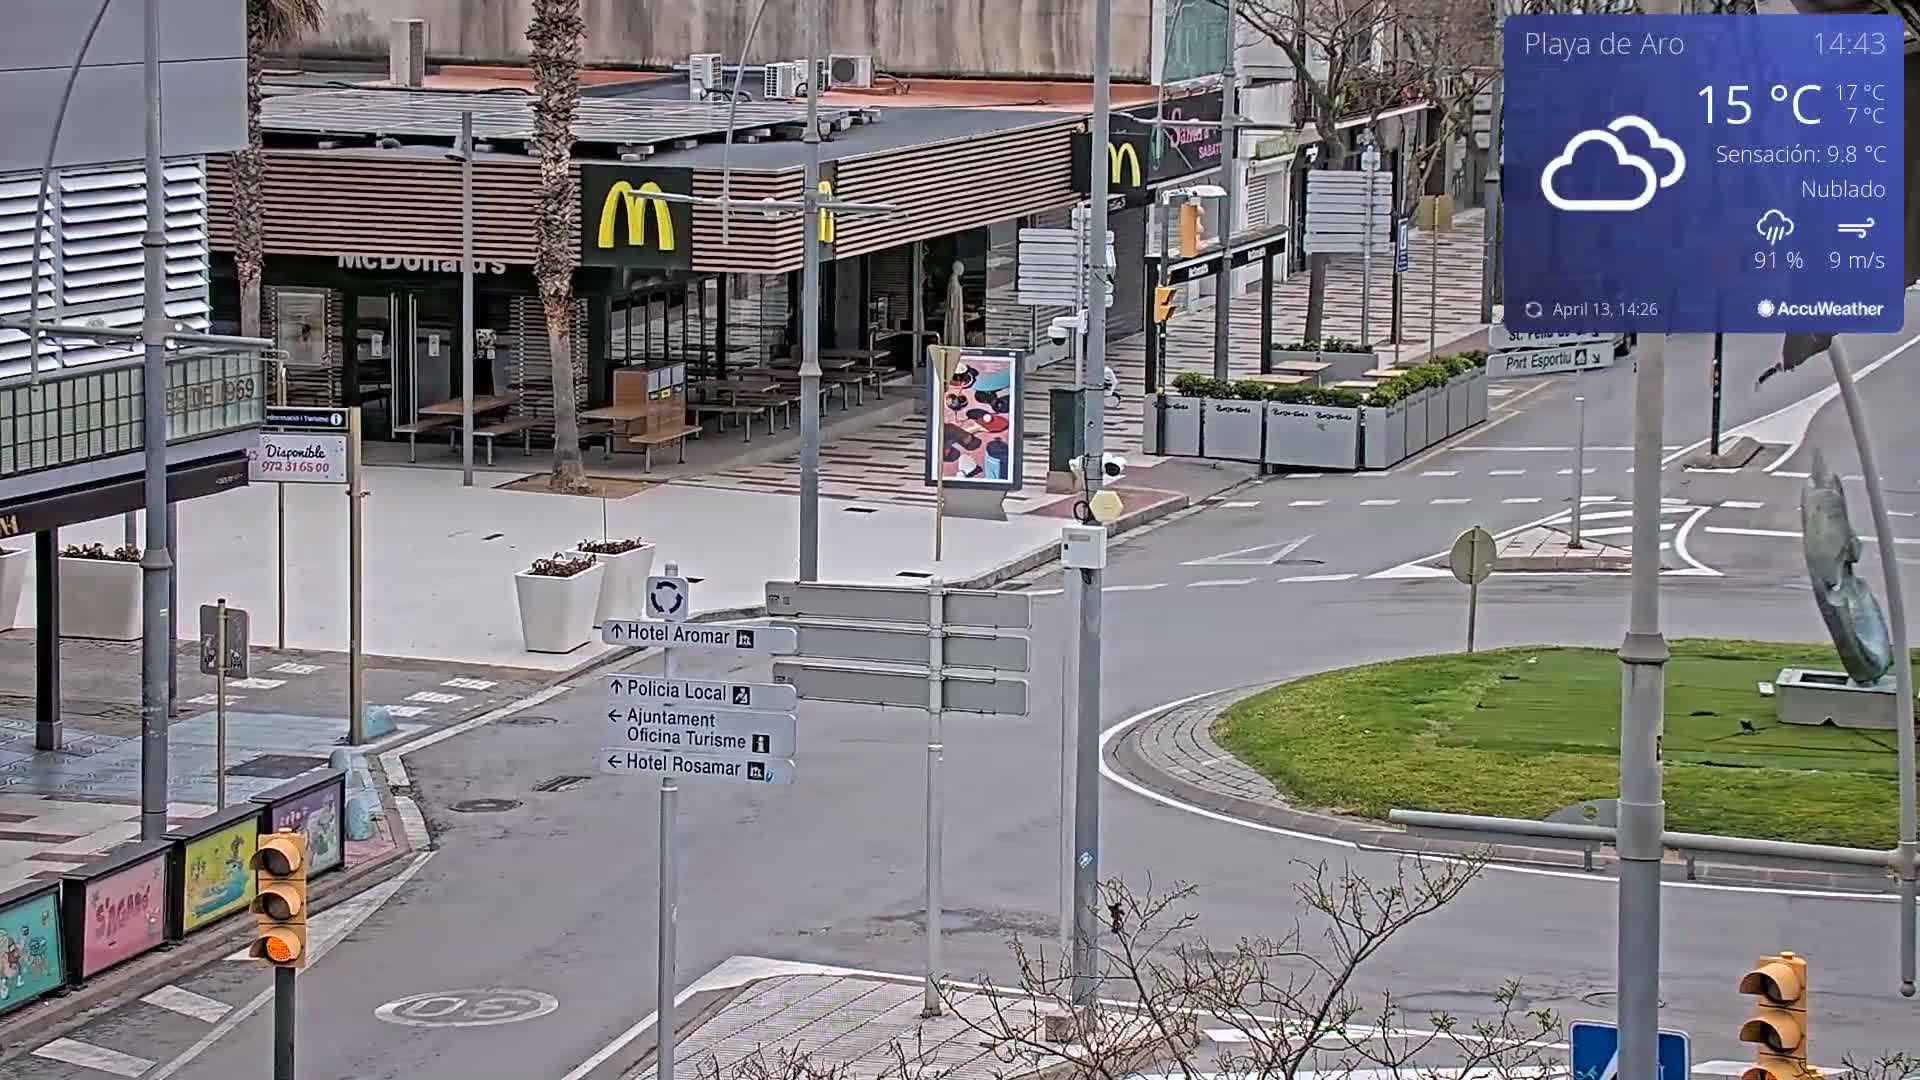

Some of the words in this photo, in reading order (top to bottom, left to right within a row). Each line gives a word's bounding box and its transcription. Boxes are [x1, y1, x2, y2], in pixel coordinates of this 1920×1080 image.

[338, 255, 507, 275] McDonads
[1506, 356, 1527, 370] Port
[1531, 352, 1572, 370] Esportiu
[265, 444, 326, 460] Disponible
[262, 461, 283, 473] 972
[285, 461, 298, 472] 31
[299, 461, 314, 473] 65
[315, 462, 330, 473] 00
[627, 623, 669, 642] Hotel
[673, 626, 731, 645] Aromar
[627, 679, 680, 699] Policia
[685, 682, 727, 701] Local
[627, 708, 716, 728] Ajuntament
[627, 726, 681, 745] Oficina
[685, 730, 747, 749] Turisme
[627, 753, 667, 771] Hotel
[672, 756, 741, 777] Rosamar
